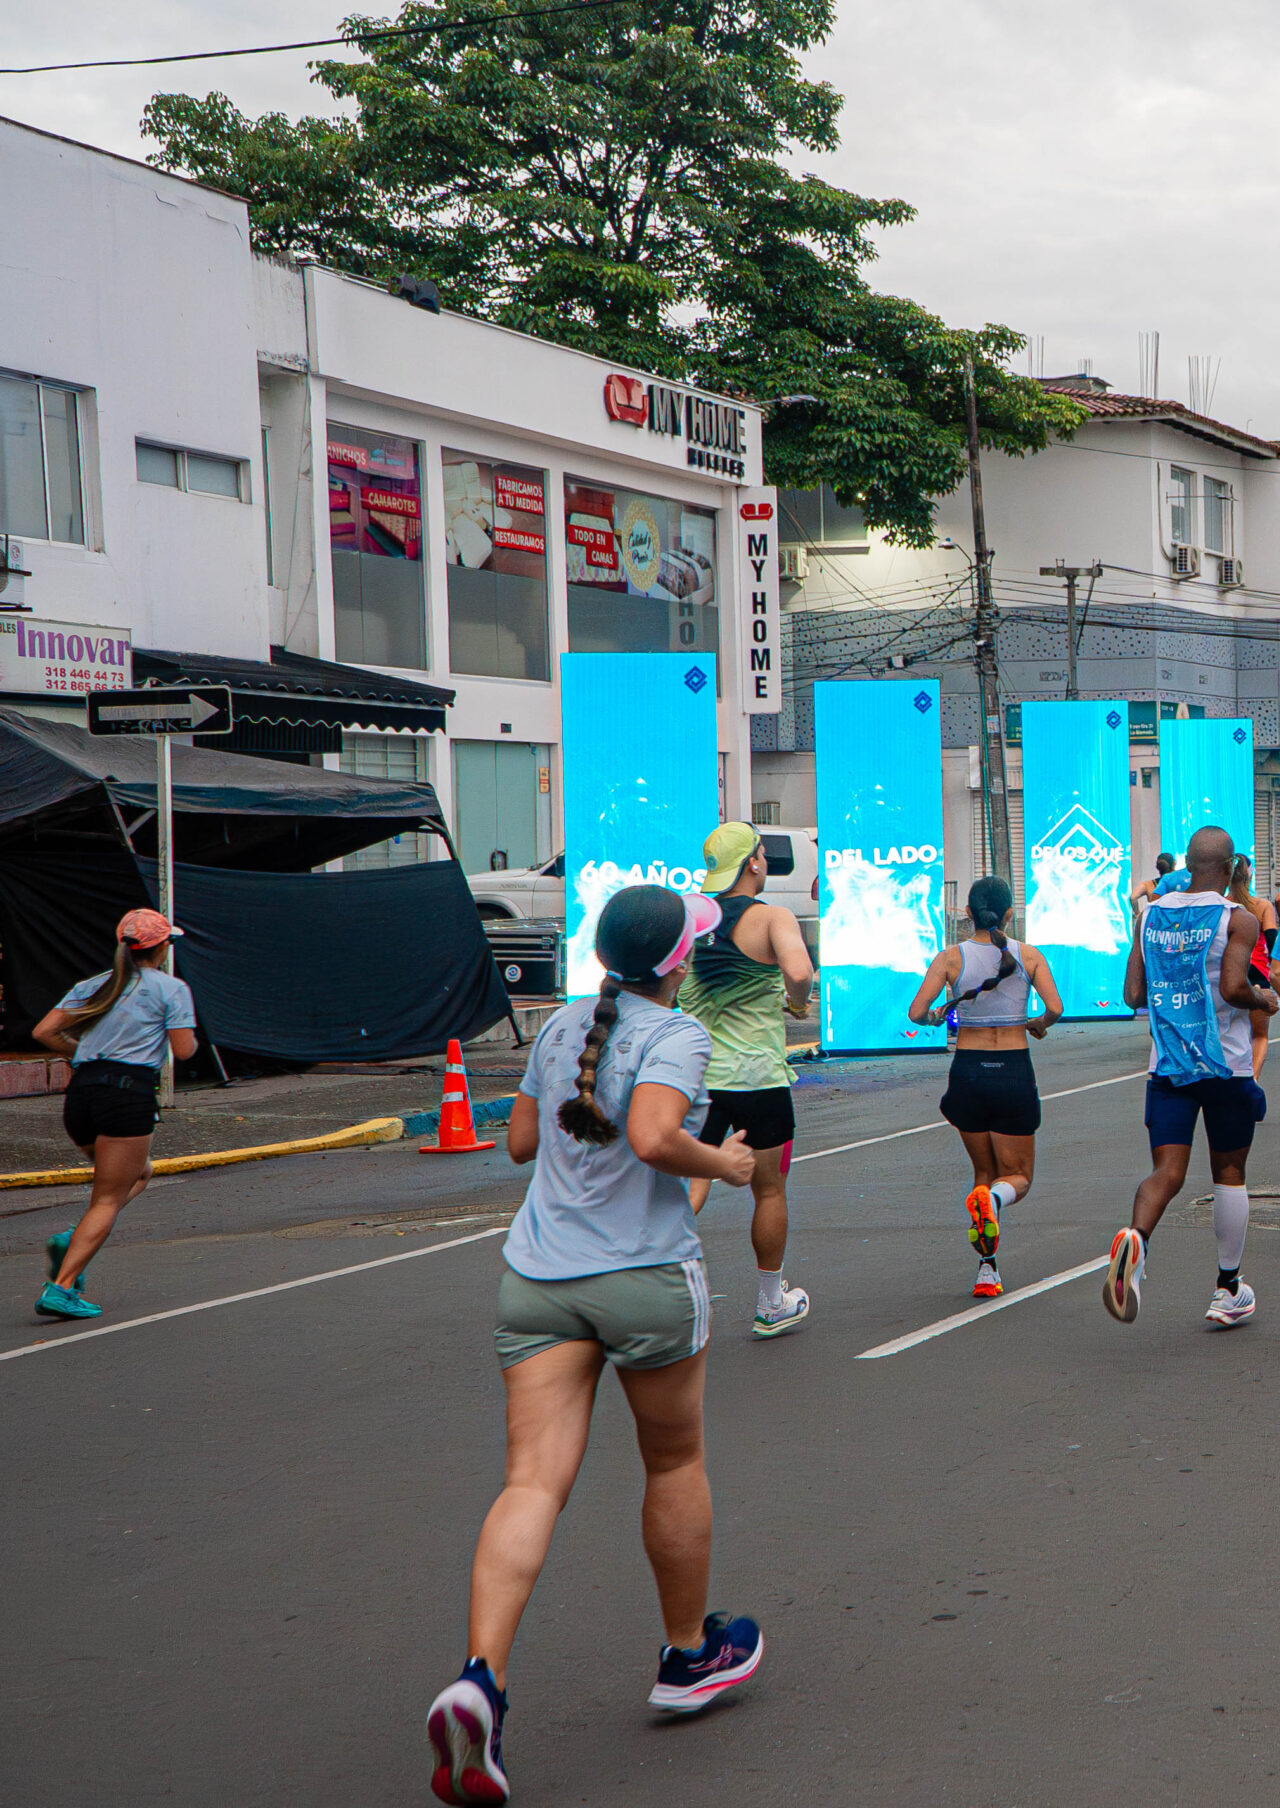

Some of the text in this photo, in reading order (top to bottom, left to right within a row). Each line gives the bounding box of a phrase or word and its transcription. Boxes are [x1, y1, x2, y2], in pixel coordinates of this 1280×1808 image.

[648, 384, 747, 454] MY HOME
[498, 478, 543, 498] FABRICAMOS
[368, 492, 417, 513] CAMAROTES
[498, 493, 544, 513] A TU MEDIDA
[495, 530, 545, 550] RESTAURAMOS
[574, 528, 606, 546] TODO EN
[591, 550, 614, 565] CAMAS
[747, 534, 768, 583] MY
[17, 620, 131, 666] Innovar
[751, 592, 771, 699] HOME
[46, 667, 125, 683] 318 446 44 73
[46, 679, 67, 690] 312
[71, 680, 91, 692] 865
[825, 844, 938, 869] DEL LADO
[1056, 845, 1088, 860] LOS
[1088, 845, 1125, 864] QUE
[580, 860, 707, 893] 60 AÑOS
